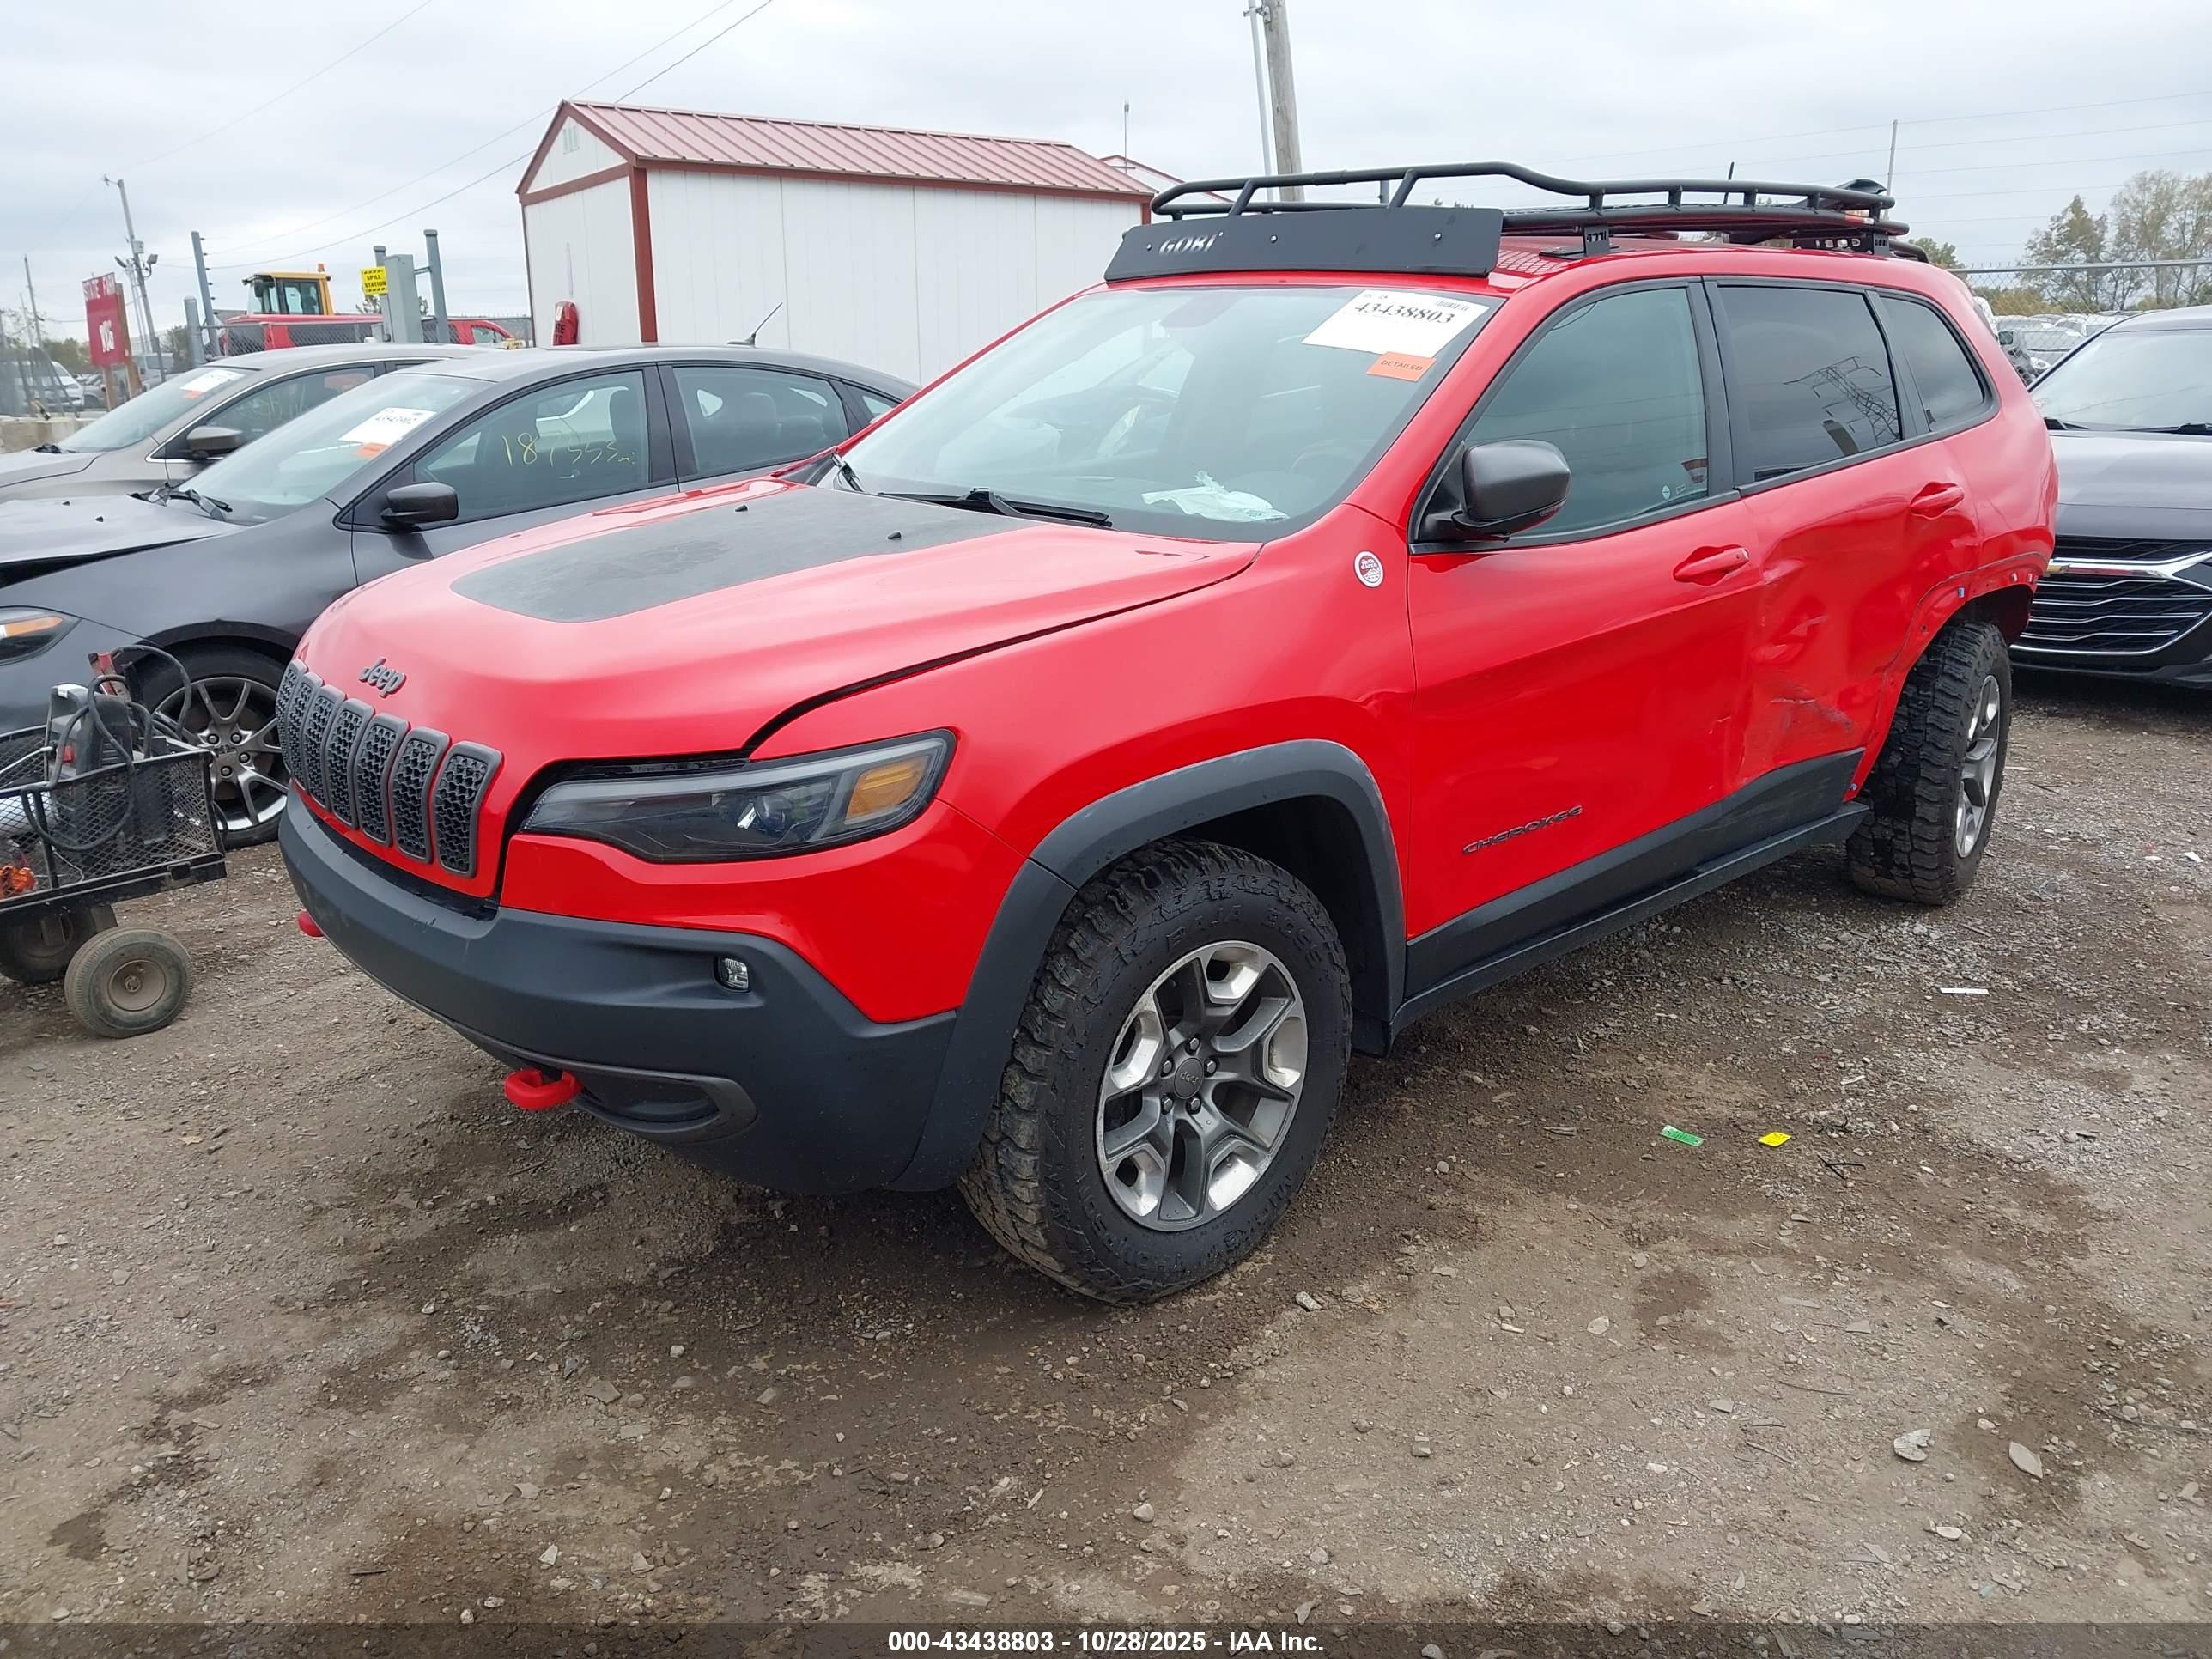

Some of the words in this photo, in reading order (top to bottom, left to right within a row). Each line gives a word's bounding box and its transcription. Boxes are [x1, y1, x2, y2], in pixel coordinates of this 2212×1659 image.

[1158, 234, 1218, 254] GOBI
[1354, 302, 1456, 324] 43438803
[1381, 360, 1423, 371] DETAILED
[359, 658, 407, 699] Jeep
[1463, 805, 1583, 853] CHEROKEE
